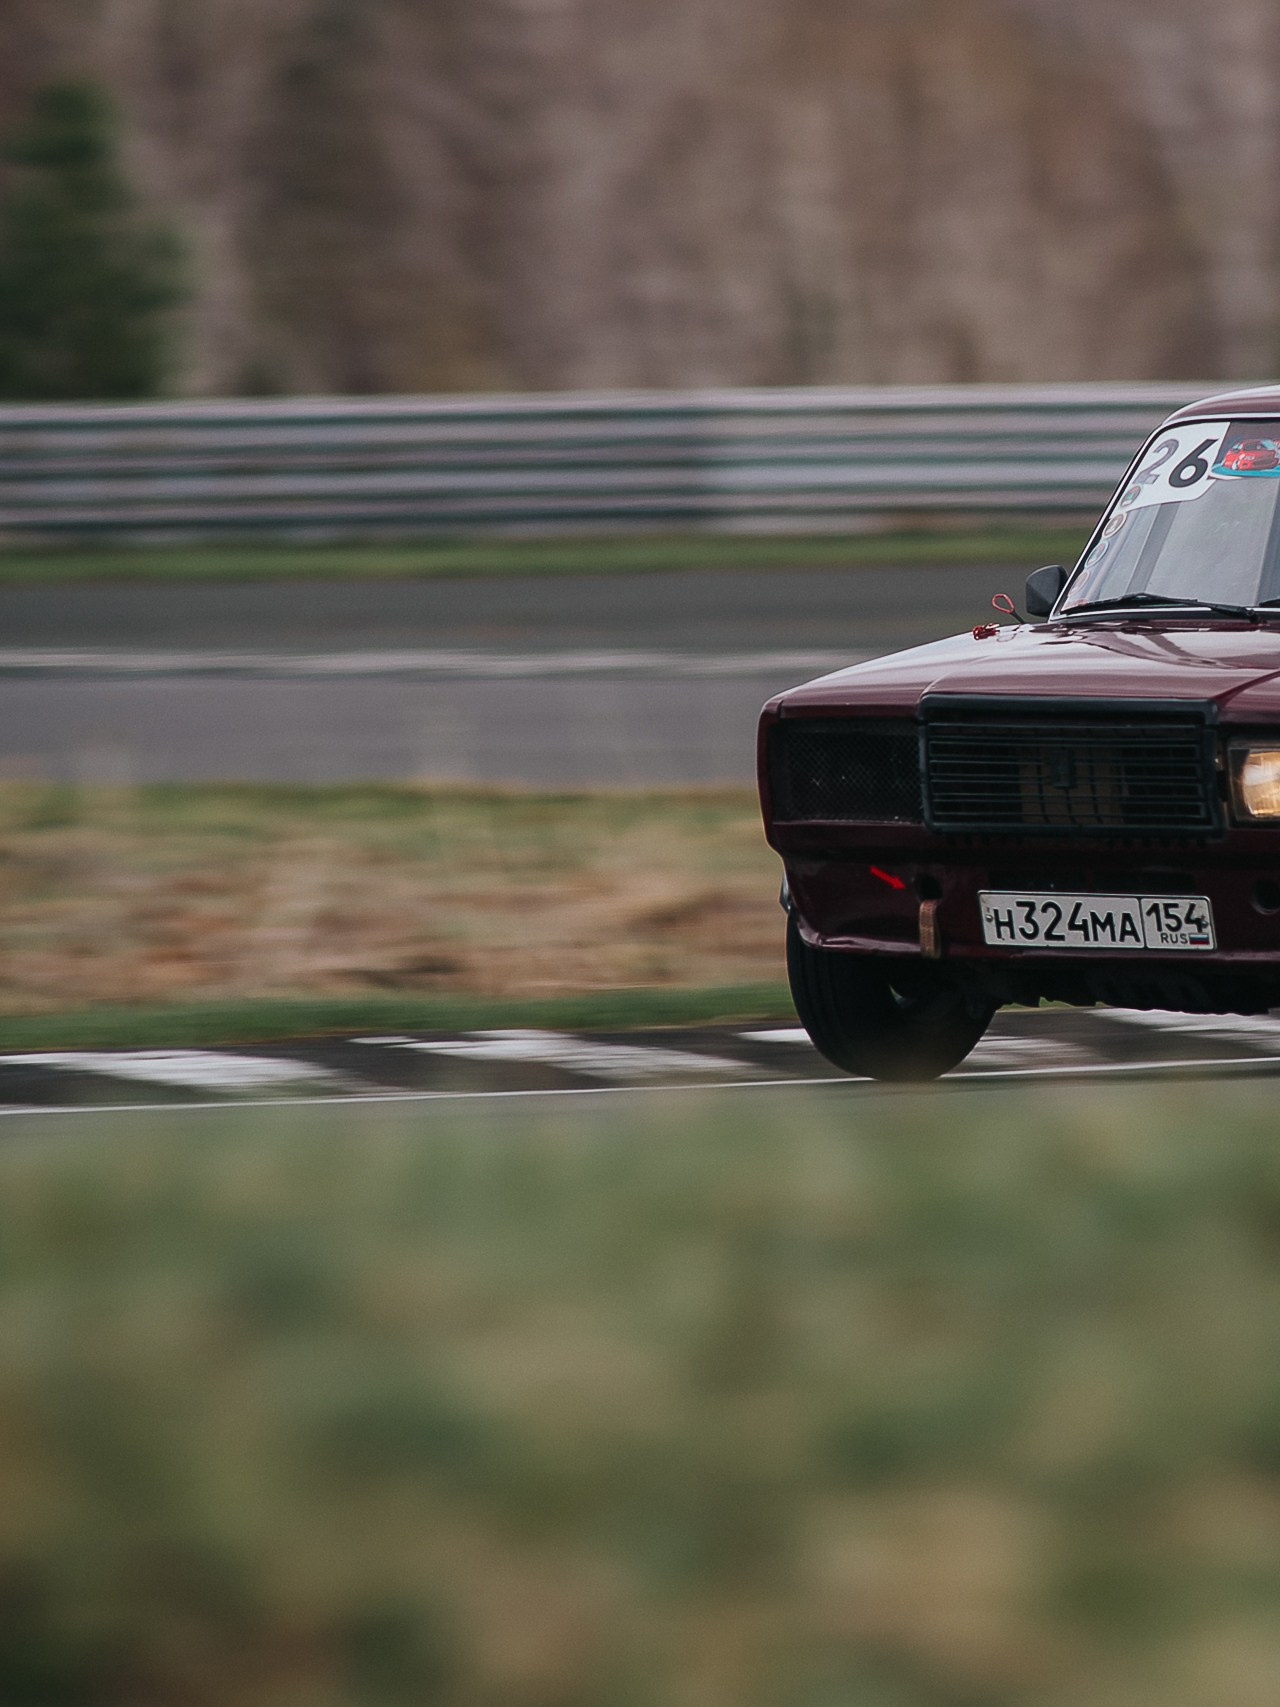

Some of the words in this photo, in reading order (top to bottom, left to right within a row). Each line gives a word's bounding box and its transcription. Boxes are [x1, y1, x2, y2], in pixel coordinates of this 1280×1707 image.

[1132, 438, 1220, 489] 26
[993, 901, 1141, 942] Н324МА
[1145, 902, 1206, 933] 154
[1160, 932, 1188, 944] RUS
